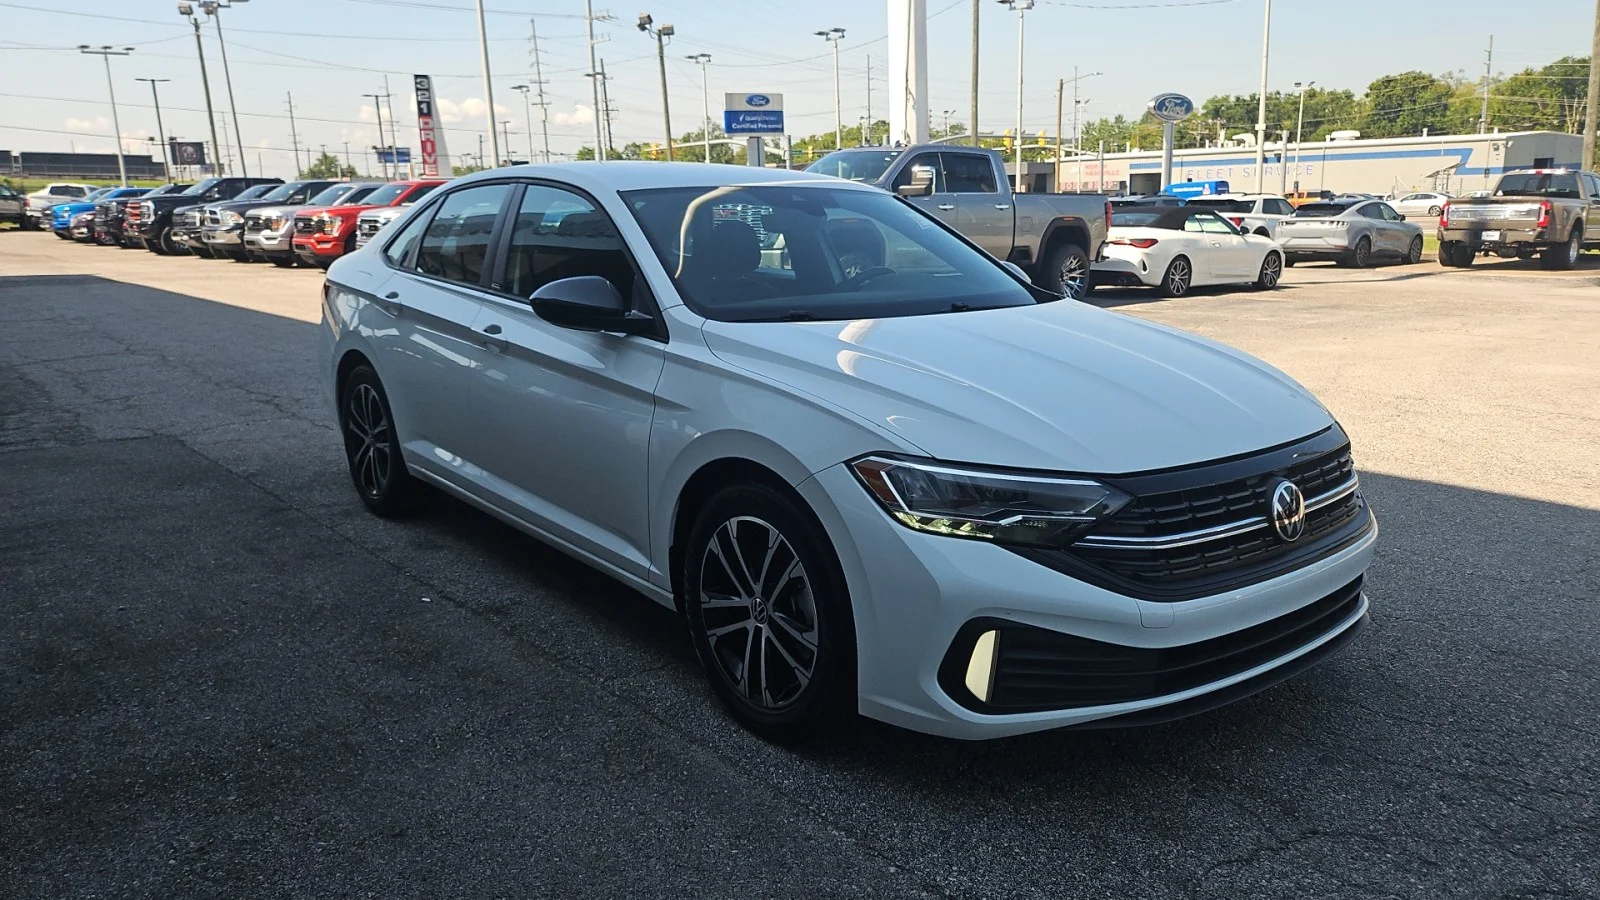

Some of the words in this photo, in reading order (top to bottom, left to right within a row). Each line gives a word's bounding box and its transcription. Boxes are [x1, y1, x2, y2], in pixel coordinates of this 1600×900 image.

[416, 78, 430, 114] 321
[1162, 98, 1187, 116] Ford
[421, 118, 437, 175] DRIVE
[1187, 168, 1233, 180] FLEET
[1060, 181, 1084, 190] BODY
